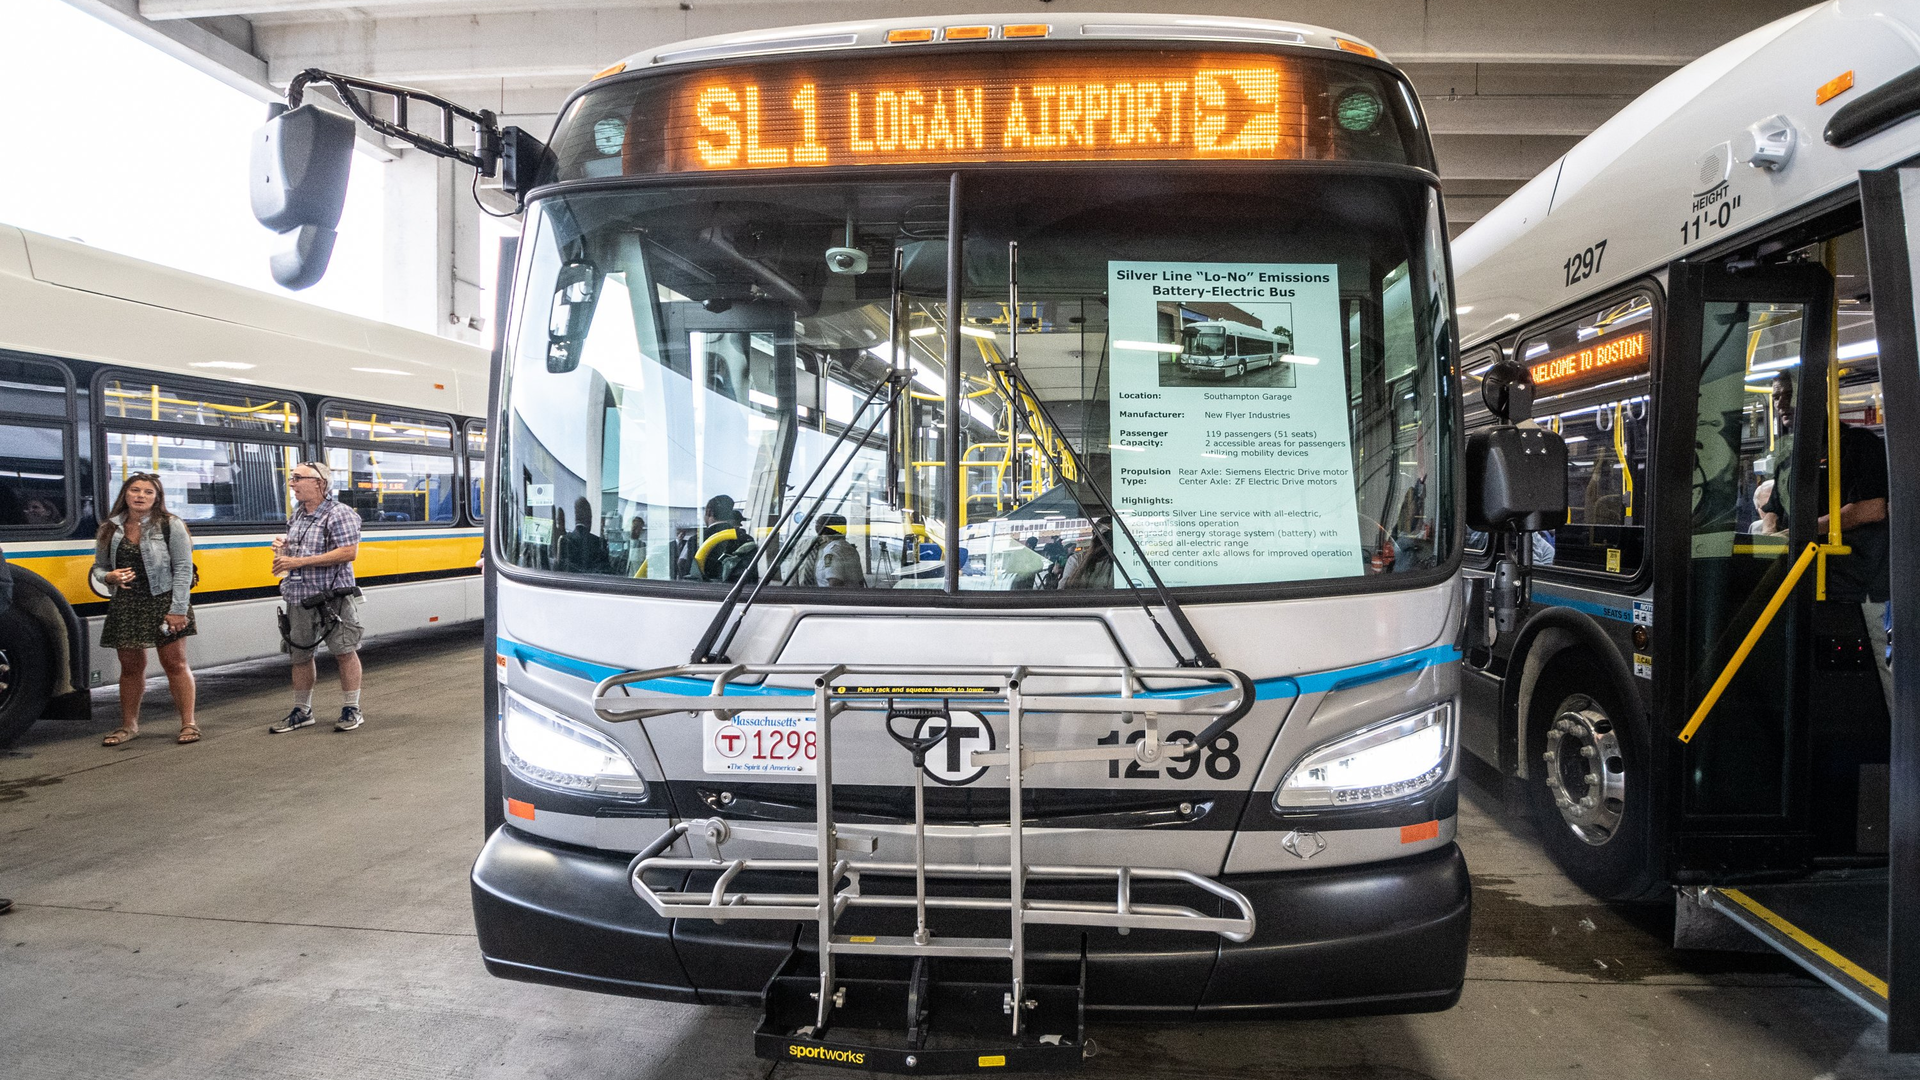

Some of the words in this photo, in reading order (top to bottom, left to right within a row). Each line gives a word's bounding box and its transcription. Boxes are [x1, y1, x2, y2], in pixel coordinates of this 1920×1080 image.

[697, 84, 827, 164] SL1
[850, 88, 983, 151] LOGAN
[1004, 81, 1188, 147] AIRPORT
[1692, 185, 1730, 213] HEIGHT
[1680, 195, 1741, 245] 11'-0"
[1563, 239, 1608, 287] 1297
[1116, 270, 1158, 281] Silver
[1162, 271, 1192, 282] Line
[1259, 272, 1330, 283] Emissions
[1152, 285, 1264, 298] Battery-Electric
[1269, 287, 1296, 297] Bus
[1532, 355, 1576, 383] WELCOME
[1580, 349, 1592, 371] TO
[1596, 333, 1643, 366] BOSTON
[1204, 393, 1260, 402] Southampton
[1262, 393, 1292, 402] Garage
[1225, 412, 1246, 420] Flyer
[1120, 430, 1168, 438] Passenger
[1274, 431, 1288, 439] (51
[1291, 431, 1317, 439] seats)
[1120, 439, 1163, 448] Capacity:
[1298, 441, 1346, 449] passengers
[1241, 450, 1274, 458] mobility
[1121, 468, 1171, 476] Propulsion
[1264, 468, 1295, 476] Electric
[1298, 468, 1320, 476] Drive
[1121, 478, 1147, 486] Type:
[1121, 497, 1174, 506] Highlights:
[1131, 510, 1170, 518] Supports
[1274, 510, 1322, 518] all-electric,
[1198, 520, 1240, 528] operation
[1176, 530, 1205, 538] energy
[1209, 530, 1241, 538] storage
[1243, 530, 1275, 538] system
[1277, 530, 1317, 538] (battery)
[1267, 550, 1308, 558] improved
[1311, 550, 1353, 558] operation
[1603, 608, 1622, 618] SEATS
[1624, 612, 1630, 620] 51
[731, 716, 797, 727] Massachusetts
[721, 735, 740, 752] T
[752, 730, 816, 760] 1298
[789, 1045, 865, 1064] sportworks
